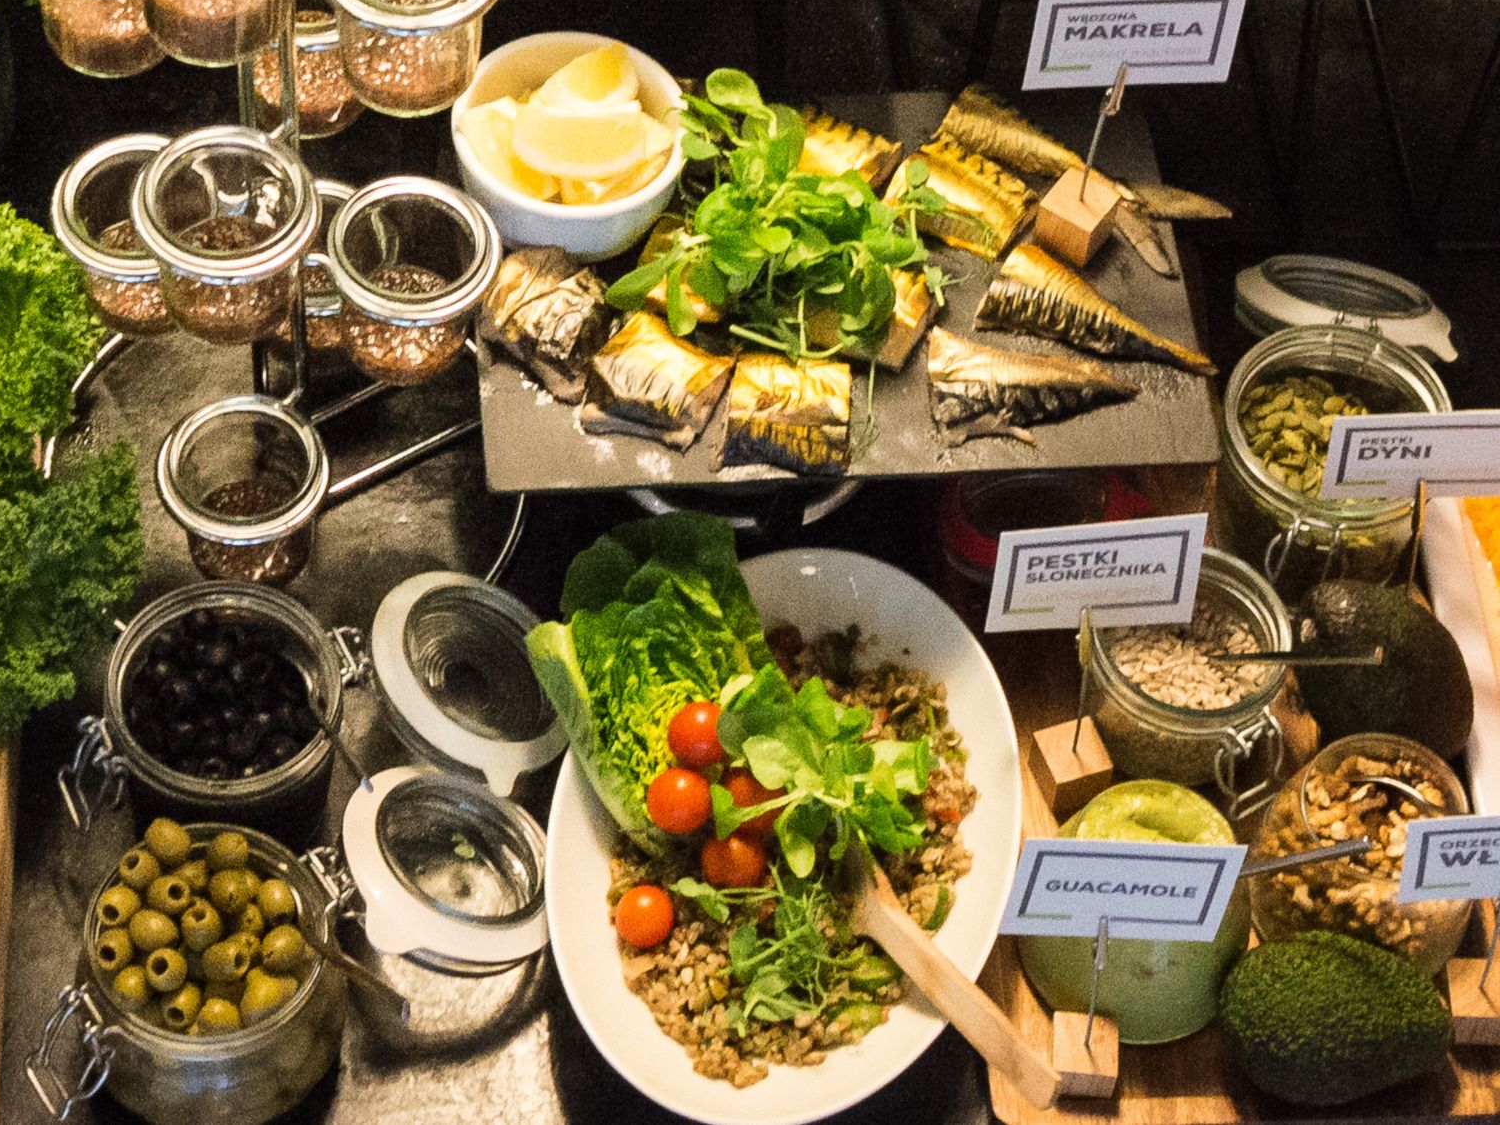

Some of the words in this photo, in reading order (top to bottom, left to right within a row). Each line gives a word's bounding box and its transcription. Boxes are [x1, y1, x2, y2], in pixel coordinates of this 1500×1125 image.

[1067, 11, 1138, 24] WĘDZONA
[1064, 22, 1203, 41] MAKRELA
[1358, 445, 1433, 460] DYNI
[1027, 549, 1118, 571] PESTKI
[1025, 562, 1166, 584] SŁONECZNIKA
[1045, 879, 1198, 899] GUACAMOLE
